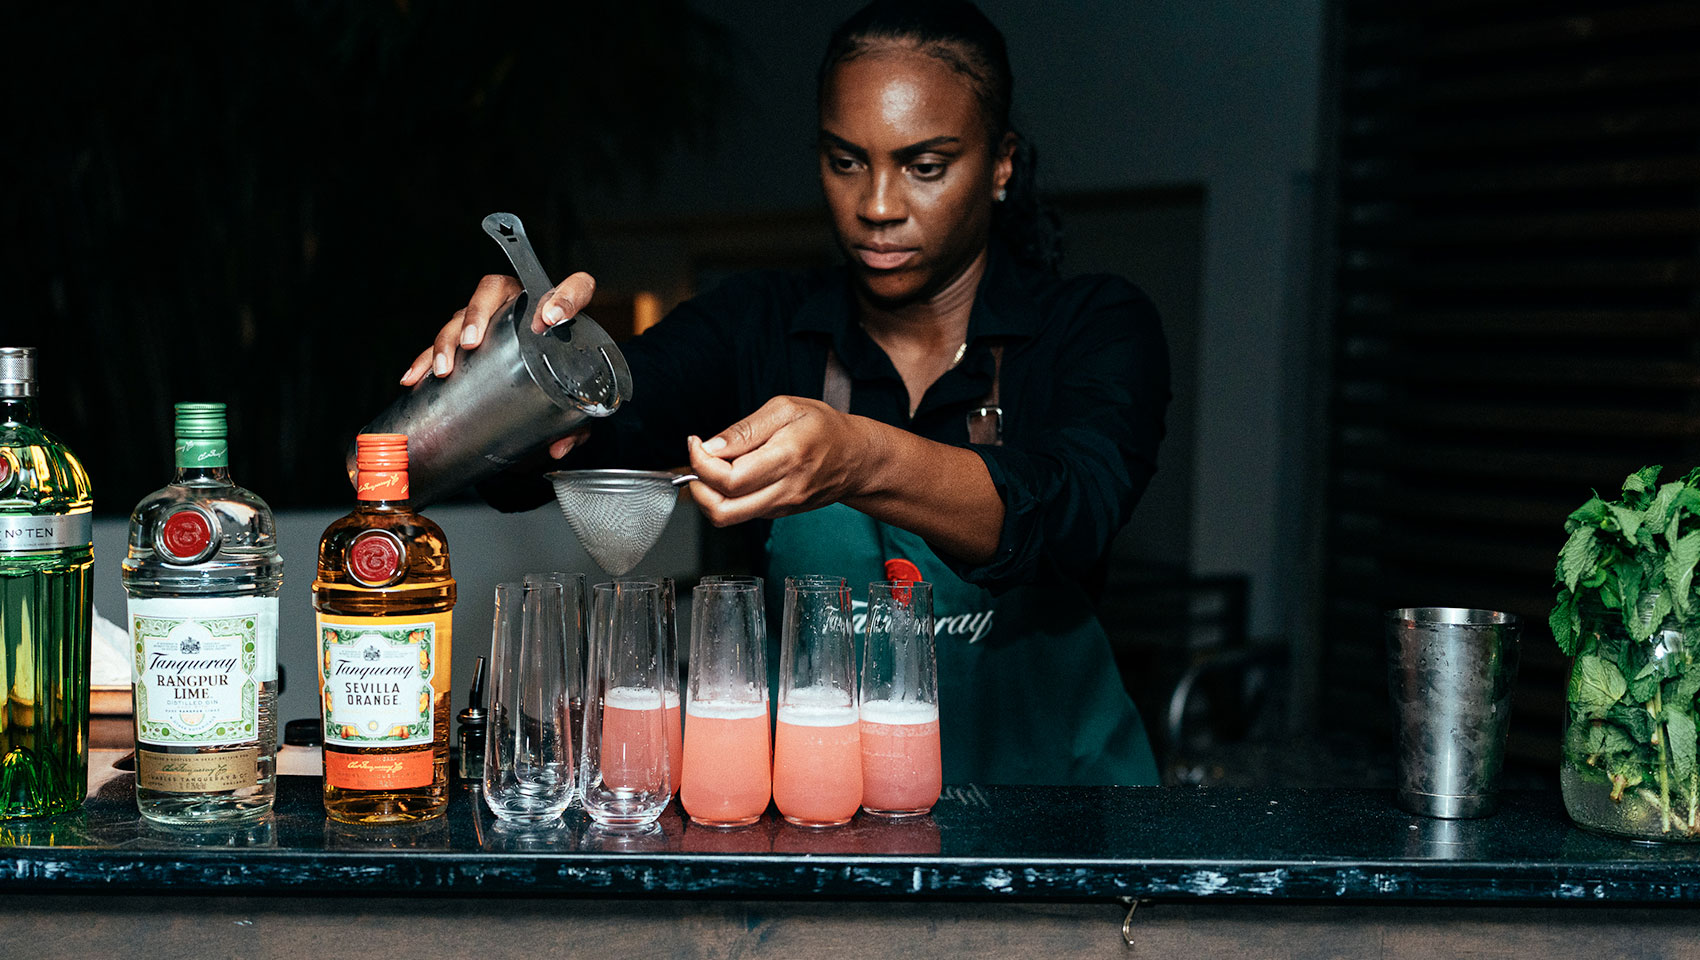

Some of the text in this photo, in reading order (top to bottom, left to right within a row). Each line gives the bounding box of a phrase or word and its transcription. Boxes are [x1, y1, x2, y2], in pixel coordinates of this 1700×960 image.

[25, 527, 54, 538] TEN
[149, 652, 237, 675] Tanqueray
[335, 659, 414, 680] Tanqueray
[156, 674, 229, 687] RANGPUR
[345, 682, 400, 693] SEVILLA
[180, 774, 230, 782] TANQUERAY
